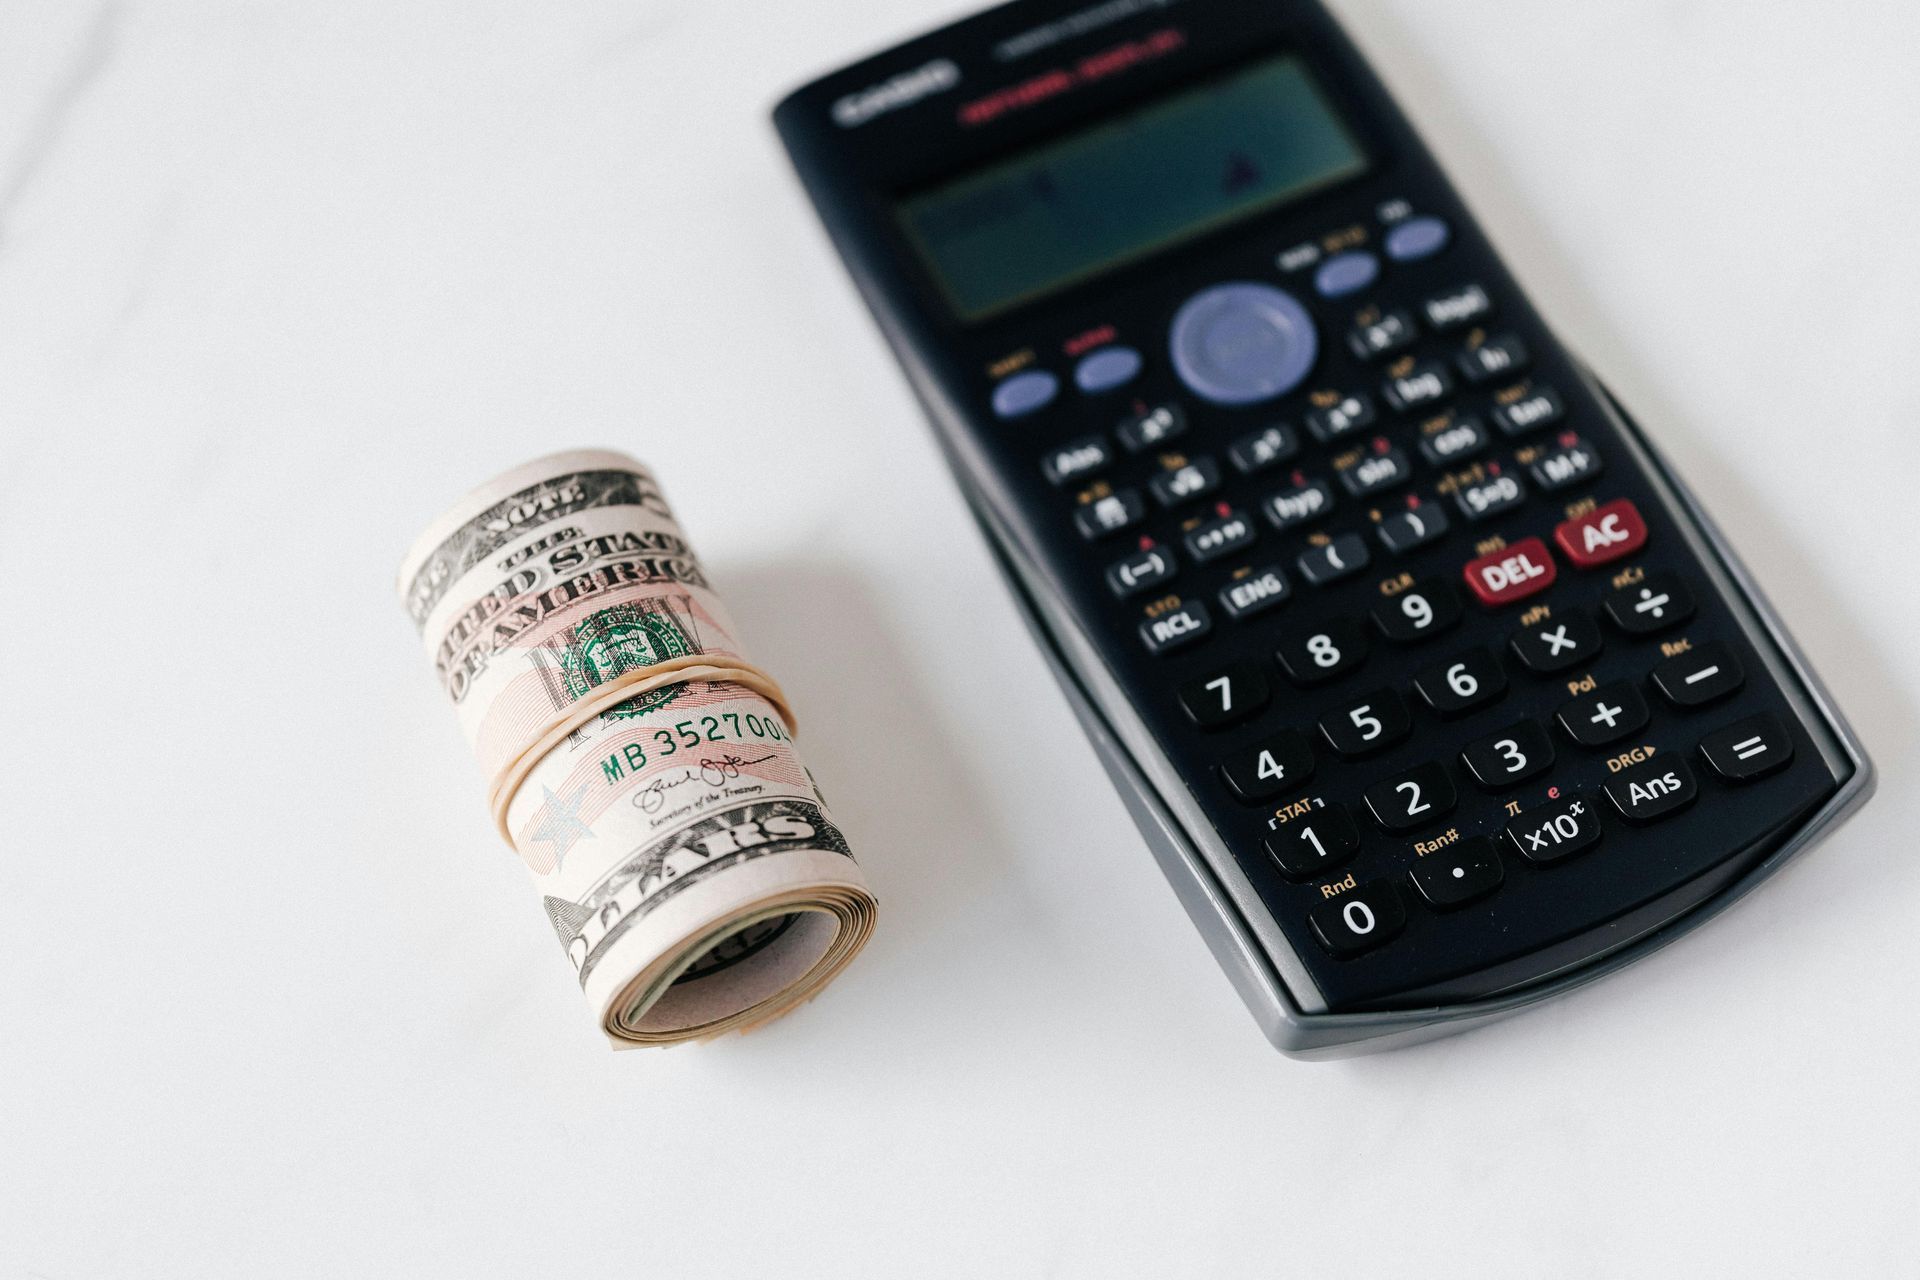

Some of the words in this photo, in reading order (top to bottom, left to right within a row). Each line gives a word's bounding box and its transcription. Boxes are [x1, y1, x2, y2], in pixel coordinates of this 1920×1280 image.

[1583, 513, 1629, 553] AC
[1481, 554, 1545, 592] DEL
[1153, 612, 1201, 642] RCL
[1401, 594, 1433, 629] 9
[1307, 634, 1341, 668] 8
[1205, 676, 1232, 711] 7
[1447, 663, 1478, 697] 6
[1567, 675, 1597, 696] Pol
[1349, 705, 1382, 741] 5
[600, 742, 647, 785] MB
[1257, 749, 1284, 780] 4
[1494, 739, 1527, 773] 3
[1395, 781, 1431, 816] 2
[1629, 771, 1682, 806] Ans
[1275, 797, 1312, 823] STAT
[1300, 826, 1327, 857] 1
[1414, 828, 1459, 857] Ran#
[1320, 873, 1357, 899] Rnd
[1343, 900, 1376, 935] 0
